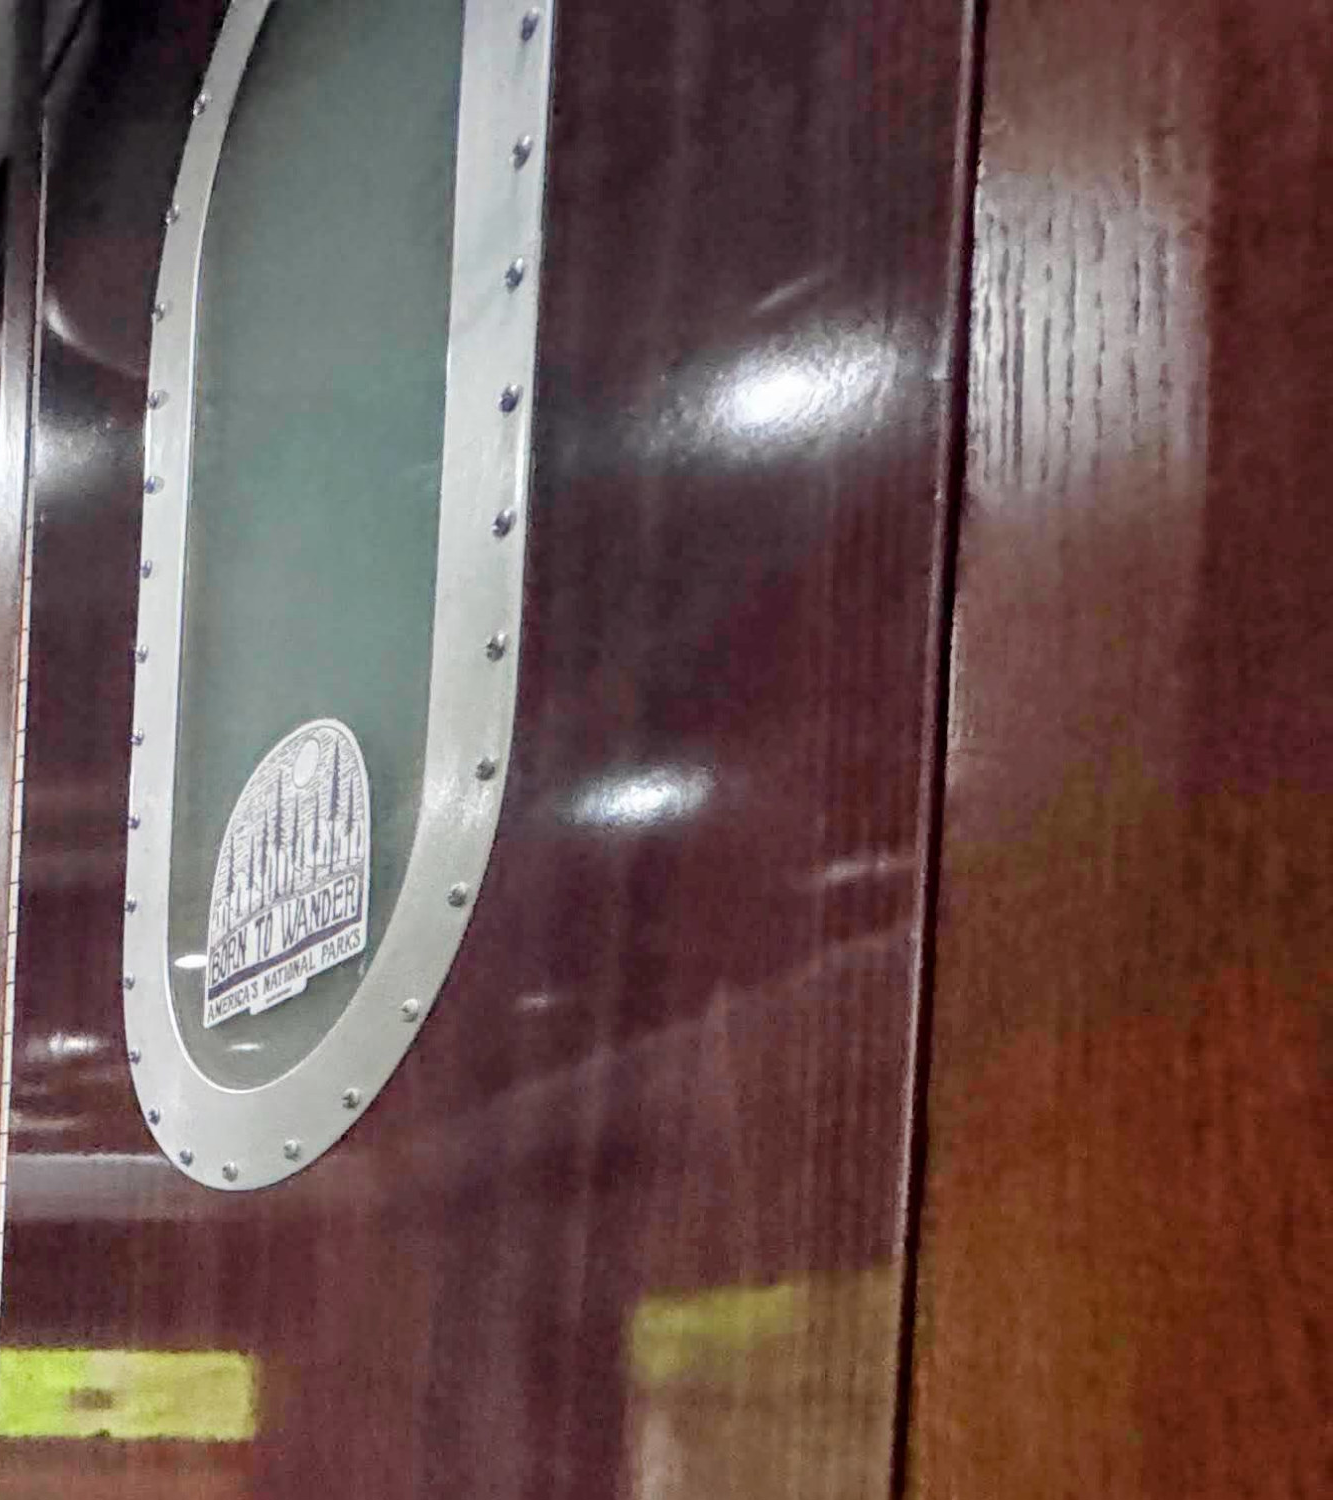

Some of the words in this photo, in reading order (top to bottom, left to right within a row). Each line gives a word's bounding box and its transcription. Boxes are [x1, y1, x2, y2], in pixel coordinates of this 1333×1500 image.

[210, 927, 248, 984] BORN
[255, 911, 274, 961] TO
[281, 875, 357, 948] WANDER
[263, 951, 316, 995] NATIONAL
[320, 928, 361, 966] PARKS
